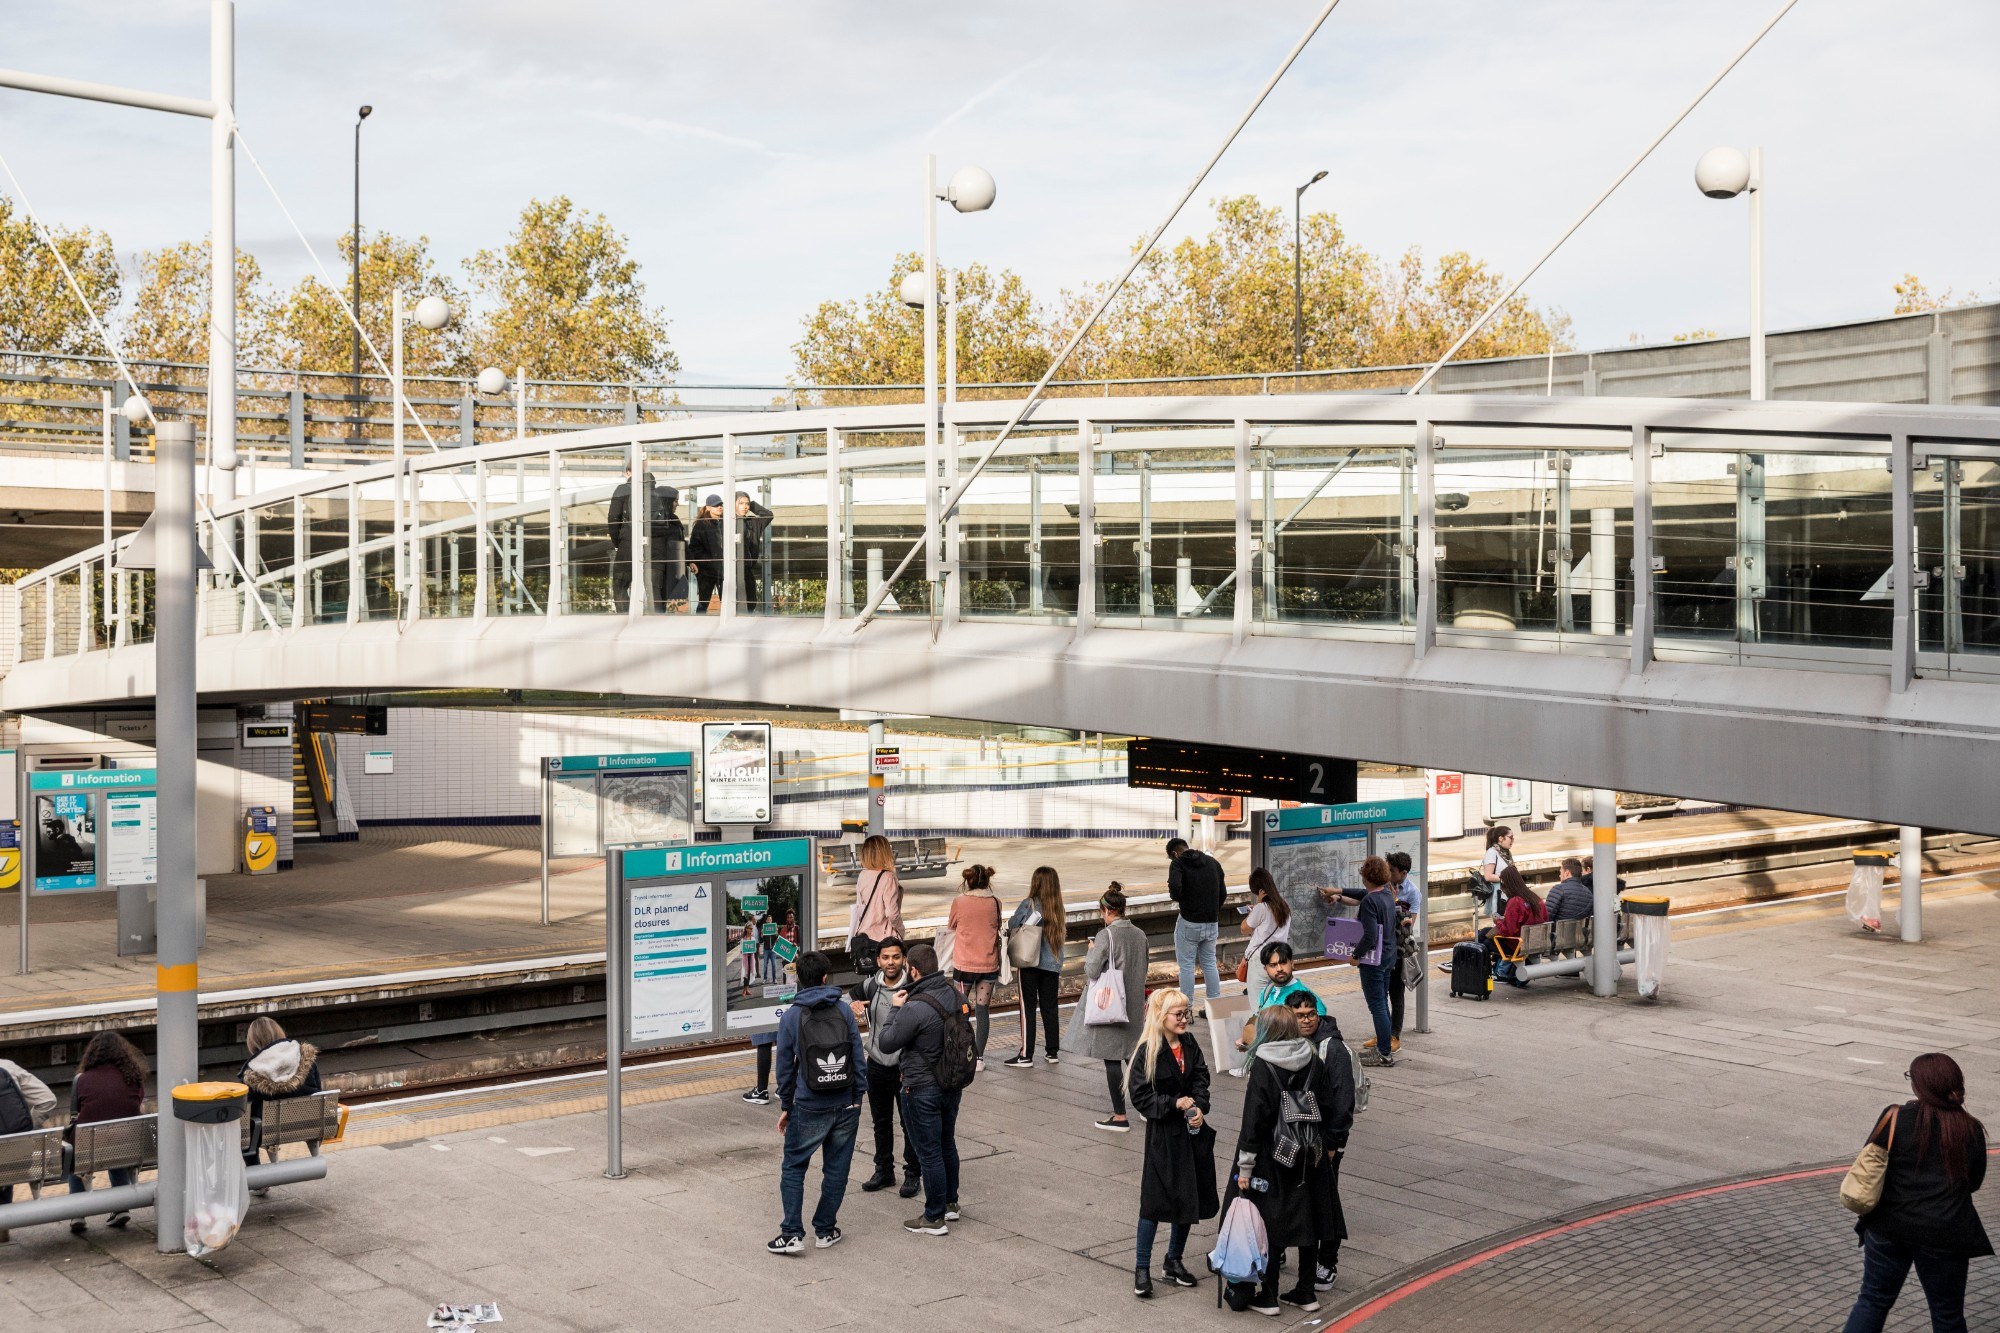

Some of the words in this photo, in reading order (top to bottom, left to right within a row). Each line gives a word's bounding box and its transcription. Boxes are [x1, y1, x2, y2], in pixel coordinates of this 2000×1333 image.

[609, 756, 657, 766] Information
[710, 767, 767, 778] UNIQUE
[1309, 762, 1325, 795] 2
[77, 773, 142, 785] Information
[1334, 806, 1387, 822] Information
[686, 849, 772, 868] Information
[744, 899, 765, 907] PLEASE
[634, 906, 652, 916] DLR
[654, 903, 689, 916] planned
[634, 918, 671, 928] closures
[1326, 940, 1377, 963] iage
[817, 1073, 848, 1083] adidas
